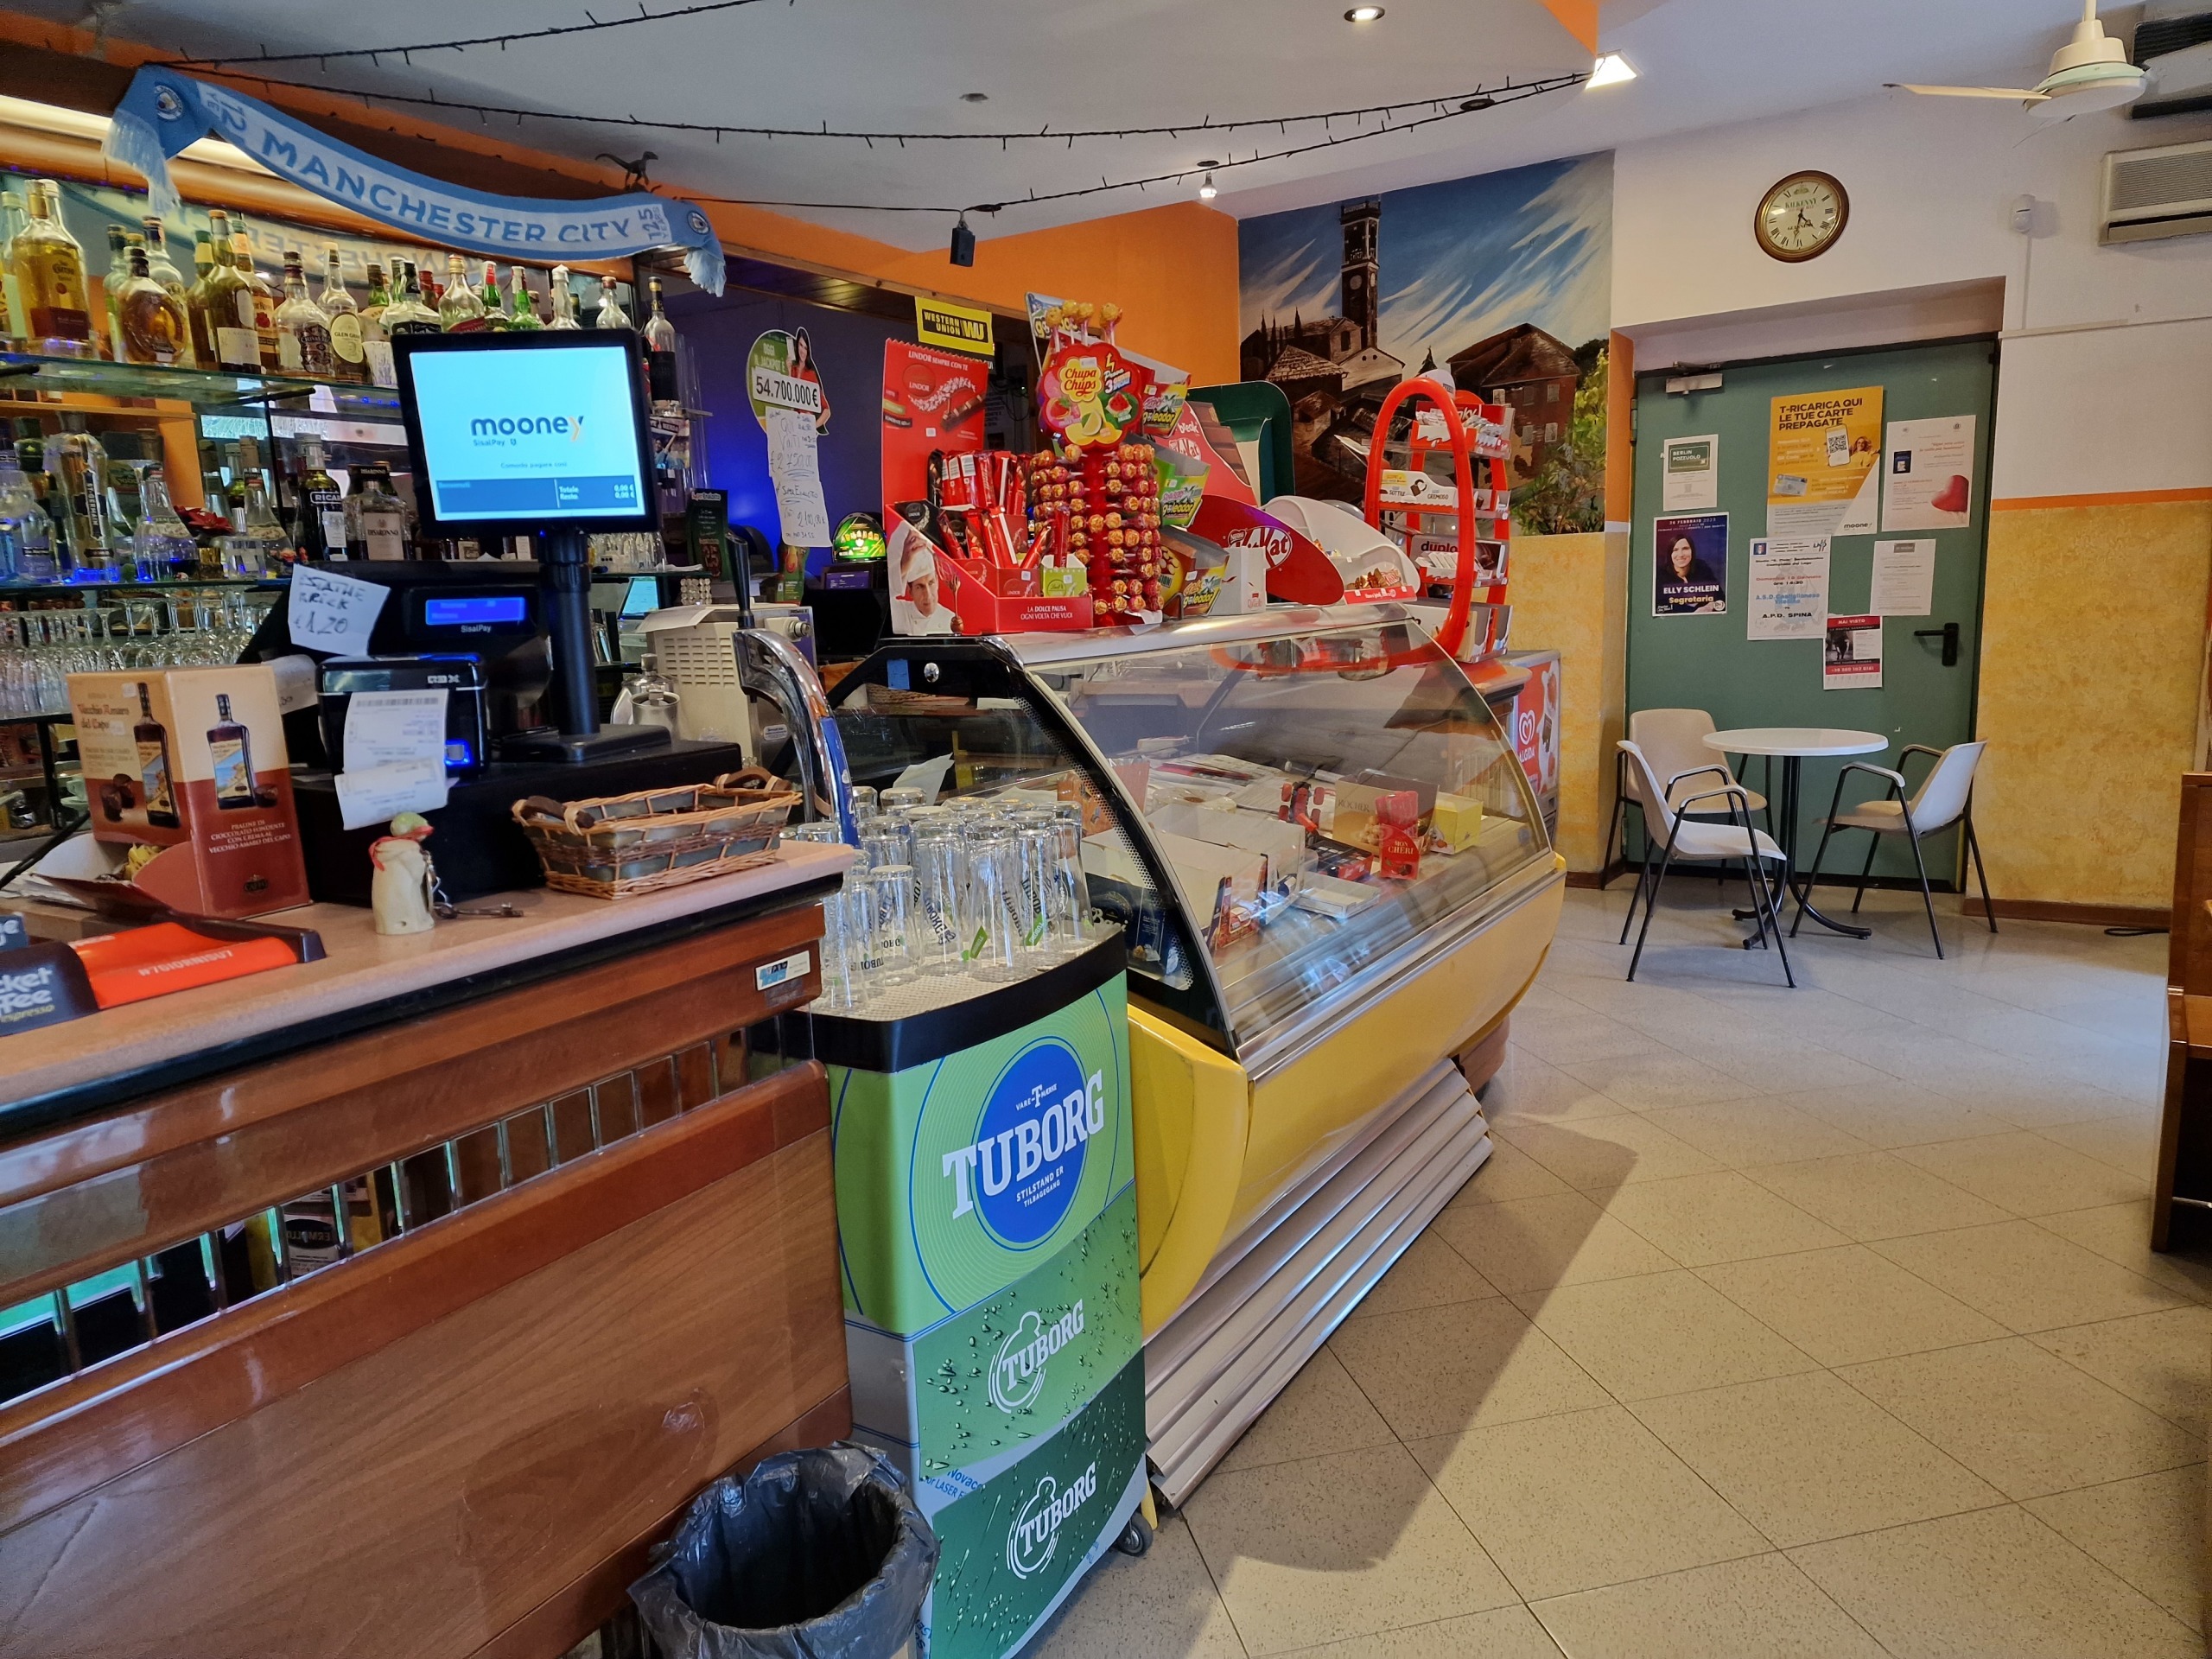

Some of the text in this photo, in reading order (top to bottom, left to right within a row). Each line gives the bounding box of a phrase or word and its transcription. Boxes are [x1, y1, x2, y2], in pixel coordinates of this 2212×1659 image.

[263, 130, 629, 243] MANCHESTER CITY
[639, 207, 662, 241] 125
[652, 206, 671, 240] YEARS
[924, 311, 985, 340] WESTERN WU
[936, 322, 961, 336] UNION
[908, 350, 932, 362] LINDOR
[950, 360, 963, 370] CON
[1065, 367, 1097, 380] Chupa
[909, 381, 930, 392] LINDOR
[1064, 378, 1096, 397] Chups
[1780, 397, 1863, 414] T-RICARICA QUI
[1779, 407, 1853, 423] LE TUE CARTE
[1779, 417, 1843, 430] PREPAGATE
[470, 416, 585, 442] mooney
[1178, 420, 1200, 434] break
[1673, 454, 1701, 462] POZZUOLO
[1683, 585, 1719, 594] SCHLEIN
[1669, 594, 1713, 605] Segretaria
[461, 624, 492, 632] SisalPay
[1519, 747, 1535, 764] ALGIDA
[1337, 798, 1370, 813] ROCHER
[211, 822, 285, 841] CIOCCOLATO FONDENTE
[231, 820, 256, 830] PRALINE
[208, 844, 238, 854] VECCHIO
[239, 839, 262, 849] AMARO
[274, 833, 291, 842] CAPO
[244, 832, 264, 842] CREMA
[1395, 839, 1408, 848] MON
[942, 1070, 1104, 1219] TUBORG
[1016, 1166, 1064, 1203] STILSTAND ER
[1023, 1179, 1060, 1208] TILBAGEGANG
[1001, 1298, 1085, 1392] TUBORG
[936, 1478, 958, 1498] LASER
[1020, 1461, 1096, 1557] TUBORG
